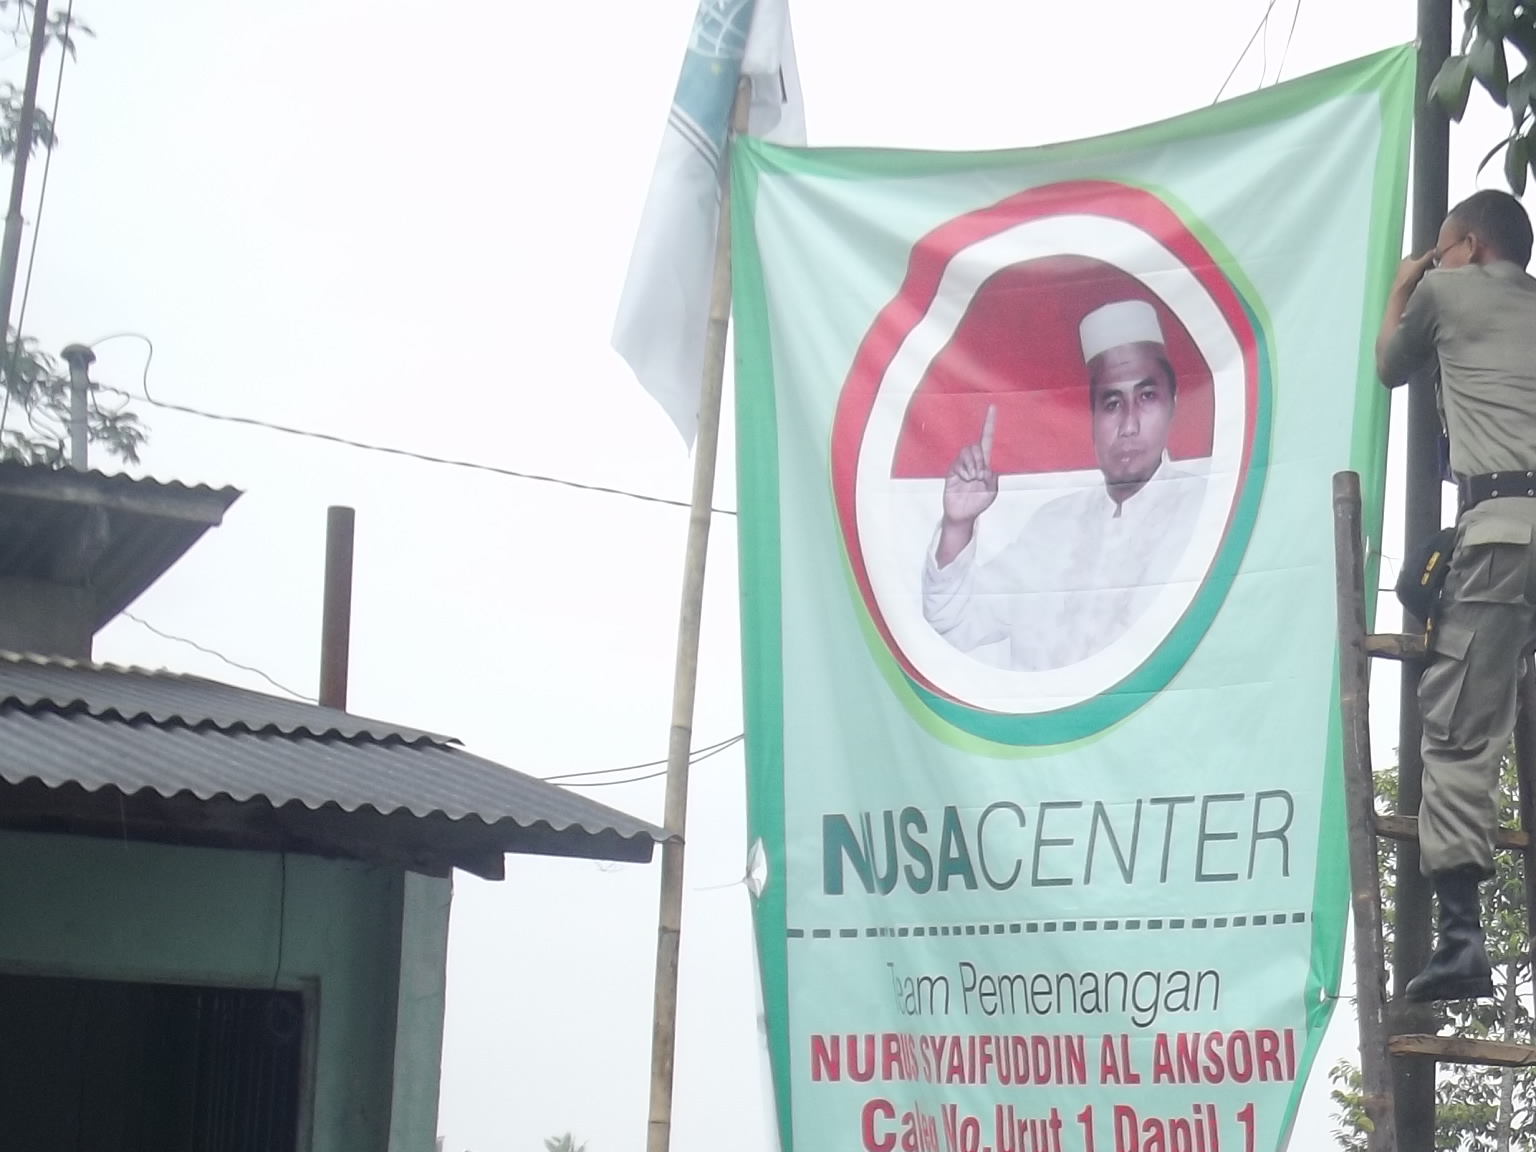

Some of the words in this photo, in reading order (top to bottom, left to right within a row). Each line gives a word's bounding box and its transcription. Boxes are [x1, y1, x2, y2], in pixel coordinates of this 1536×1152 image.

[822, 789, 1295, 896] NUSACENTER
[886, 962, 949, 1016] Team
[958, 961, 1220, 1027] Pemenangan
[919, 1033, 1086, 1085] SYAIFUDDIN
[1100, 1034, 1141, 1084] AL
[1152, 1028, 1296, 1083] ANSORI
